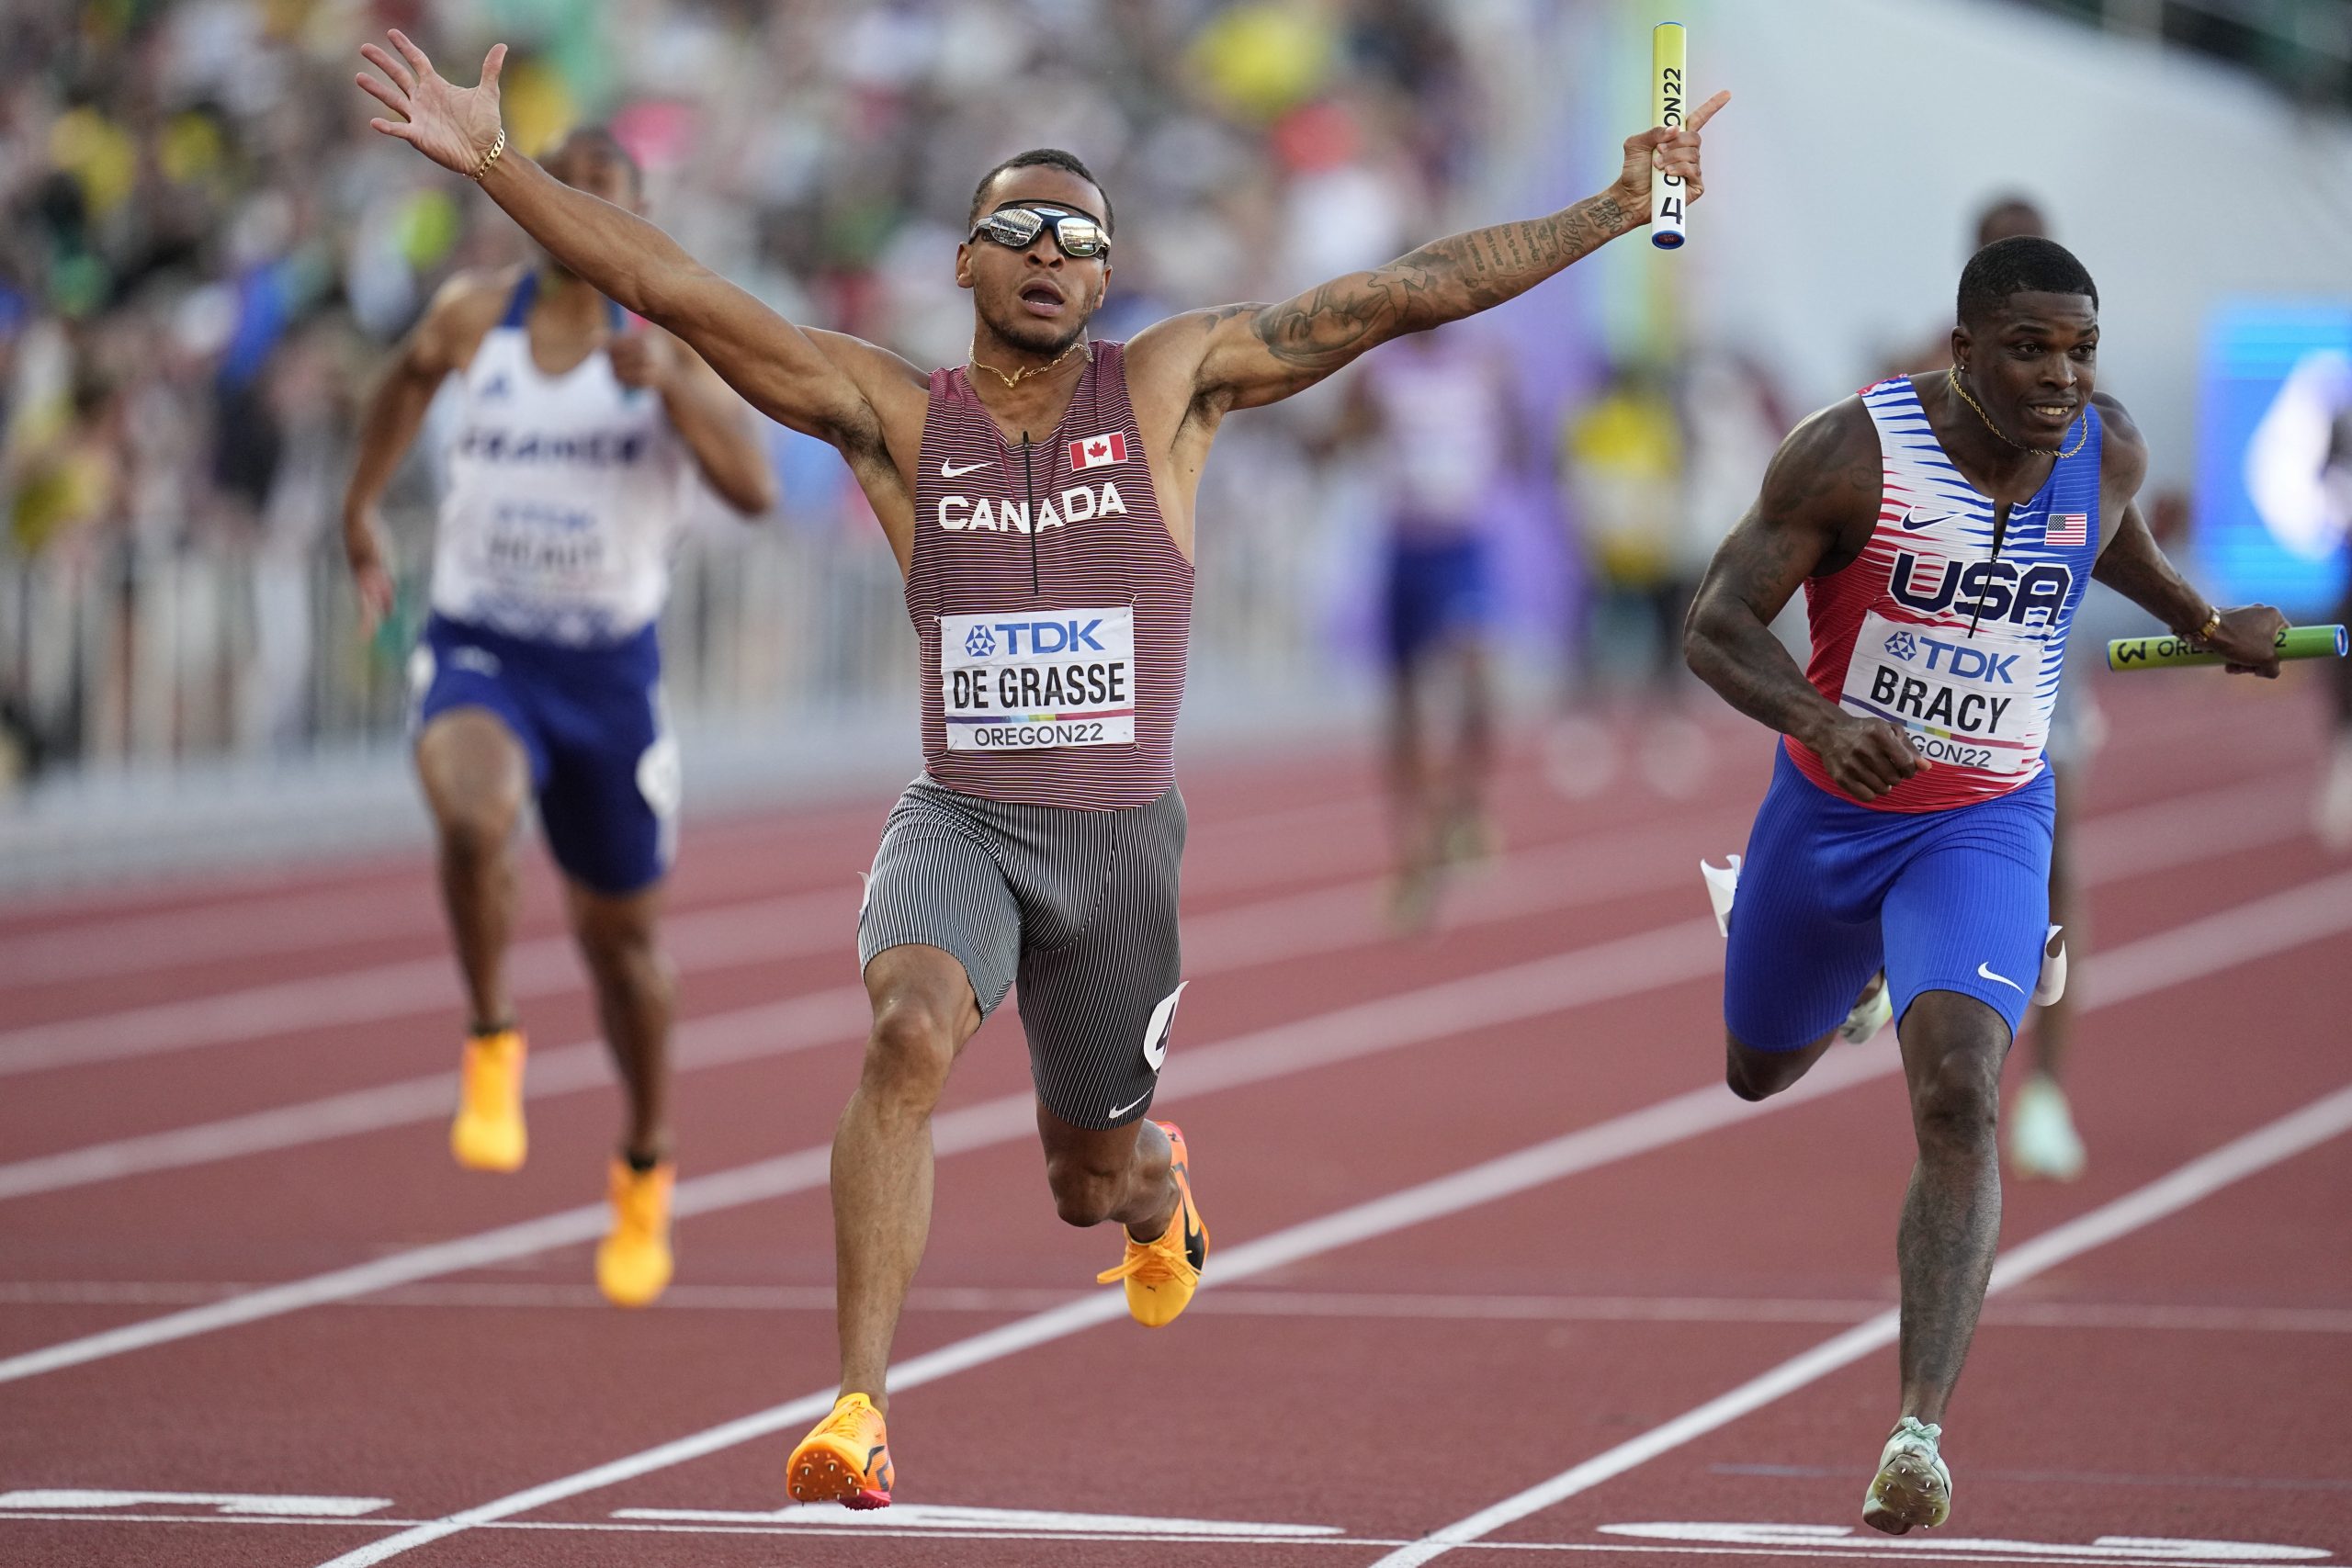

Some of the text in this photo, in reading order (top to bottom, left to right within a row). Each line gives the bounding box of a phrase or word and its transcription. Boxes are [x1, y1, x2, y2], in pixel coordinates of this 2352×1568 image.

[1663, 67, 1681, 186] OON22
[1659, 197, 1682, 225] 4
[939, 482, 1127, 534] CANADA
[1887, 547, 2074, 628] USA
[995, 619, 1105, 654] TDK
[2117, 640, 2147, 664] 3
[1919, 637, 2021, 683] TDK
[954, 662, 1125, 709] DE GRASSE
[1870, 664, 2012, 734] BRACY
[974, 723, 1103, 746] OREGON22
[1907, 732, 1992, 767] GON22
[1155, 1000, 1176, 1056] 4
